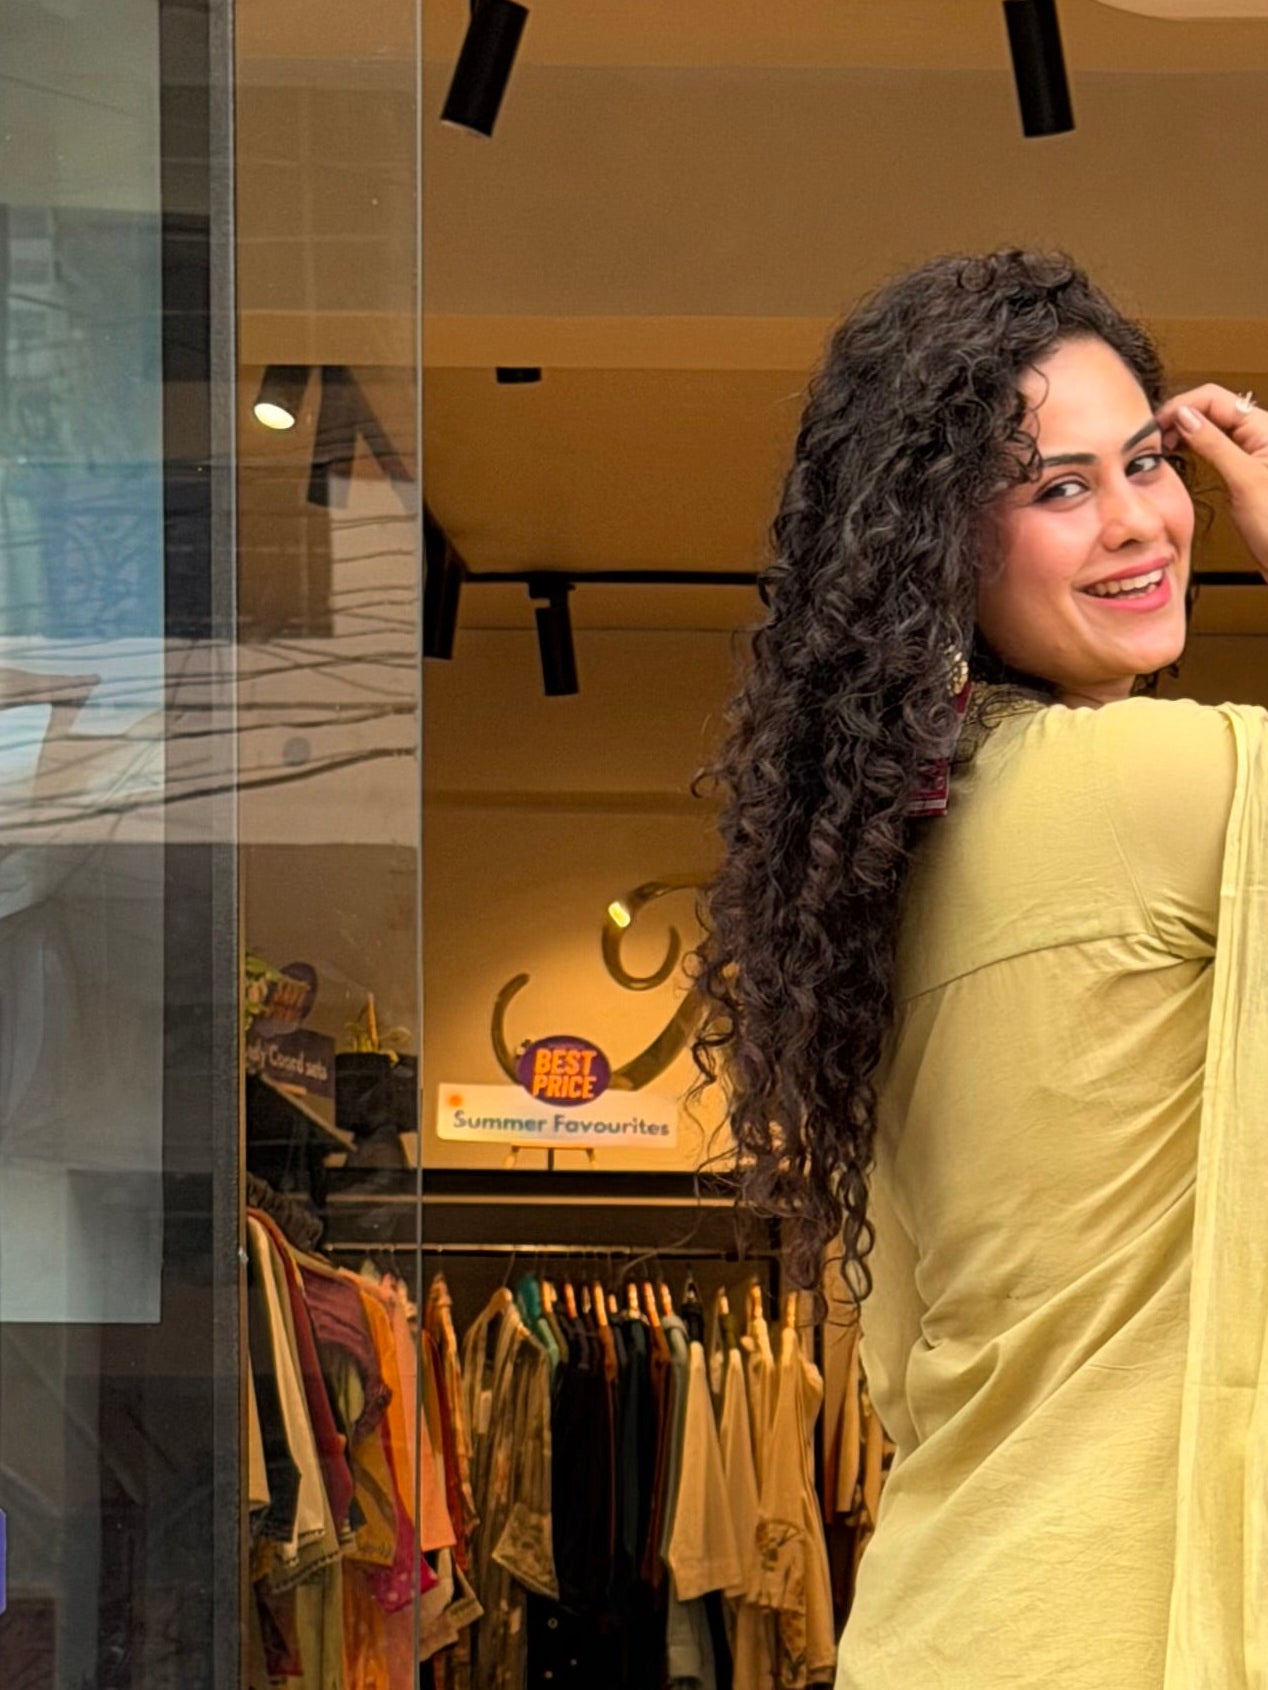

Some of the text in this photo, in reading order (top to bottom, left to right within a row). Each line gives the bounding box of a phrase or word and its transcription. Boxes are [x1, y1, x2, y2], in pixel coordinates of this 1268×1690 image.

[534, 1047, 597, 1075] BEST
[531, 1075, 597, 1099] PRICE
[453, 1109, 670, 1137] Summer Favourites
